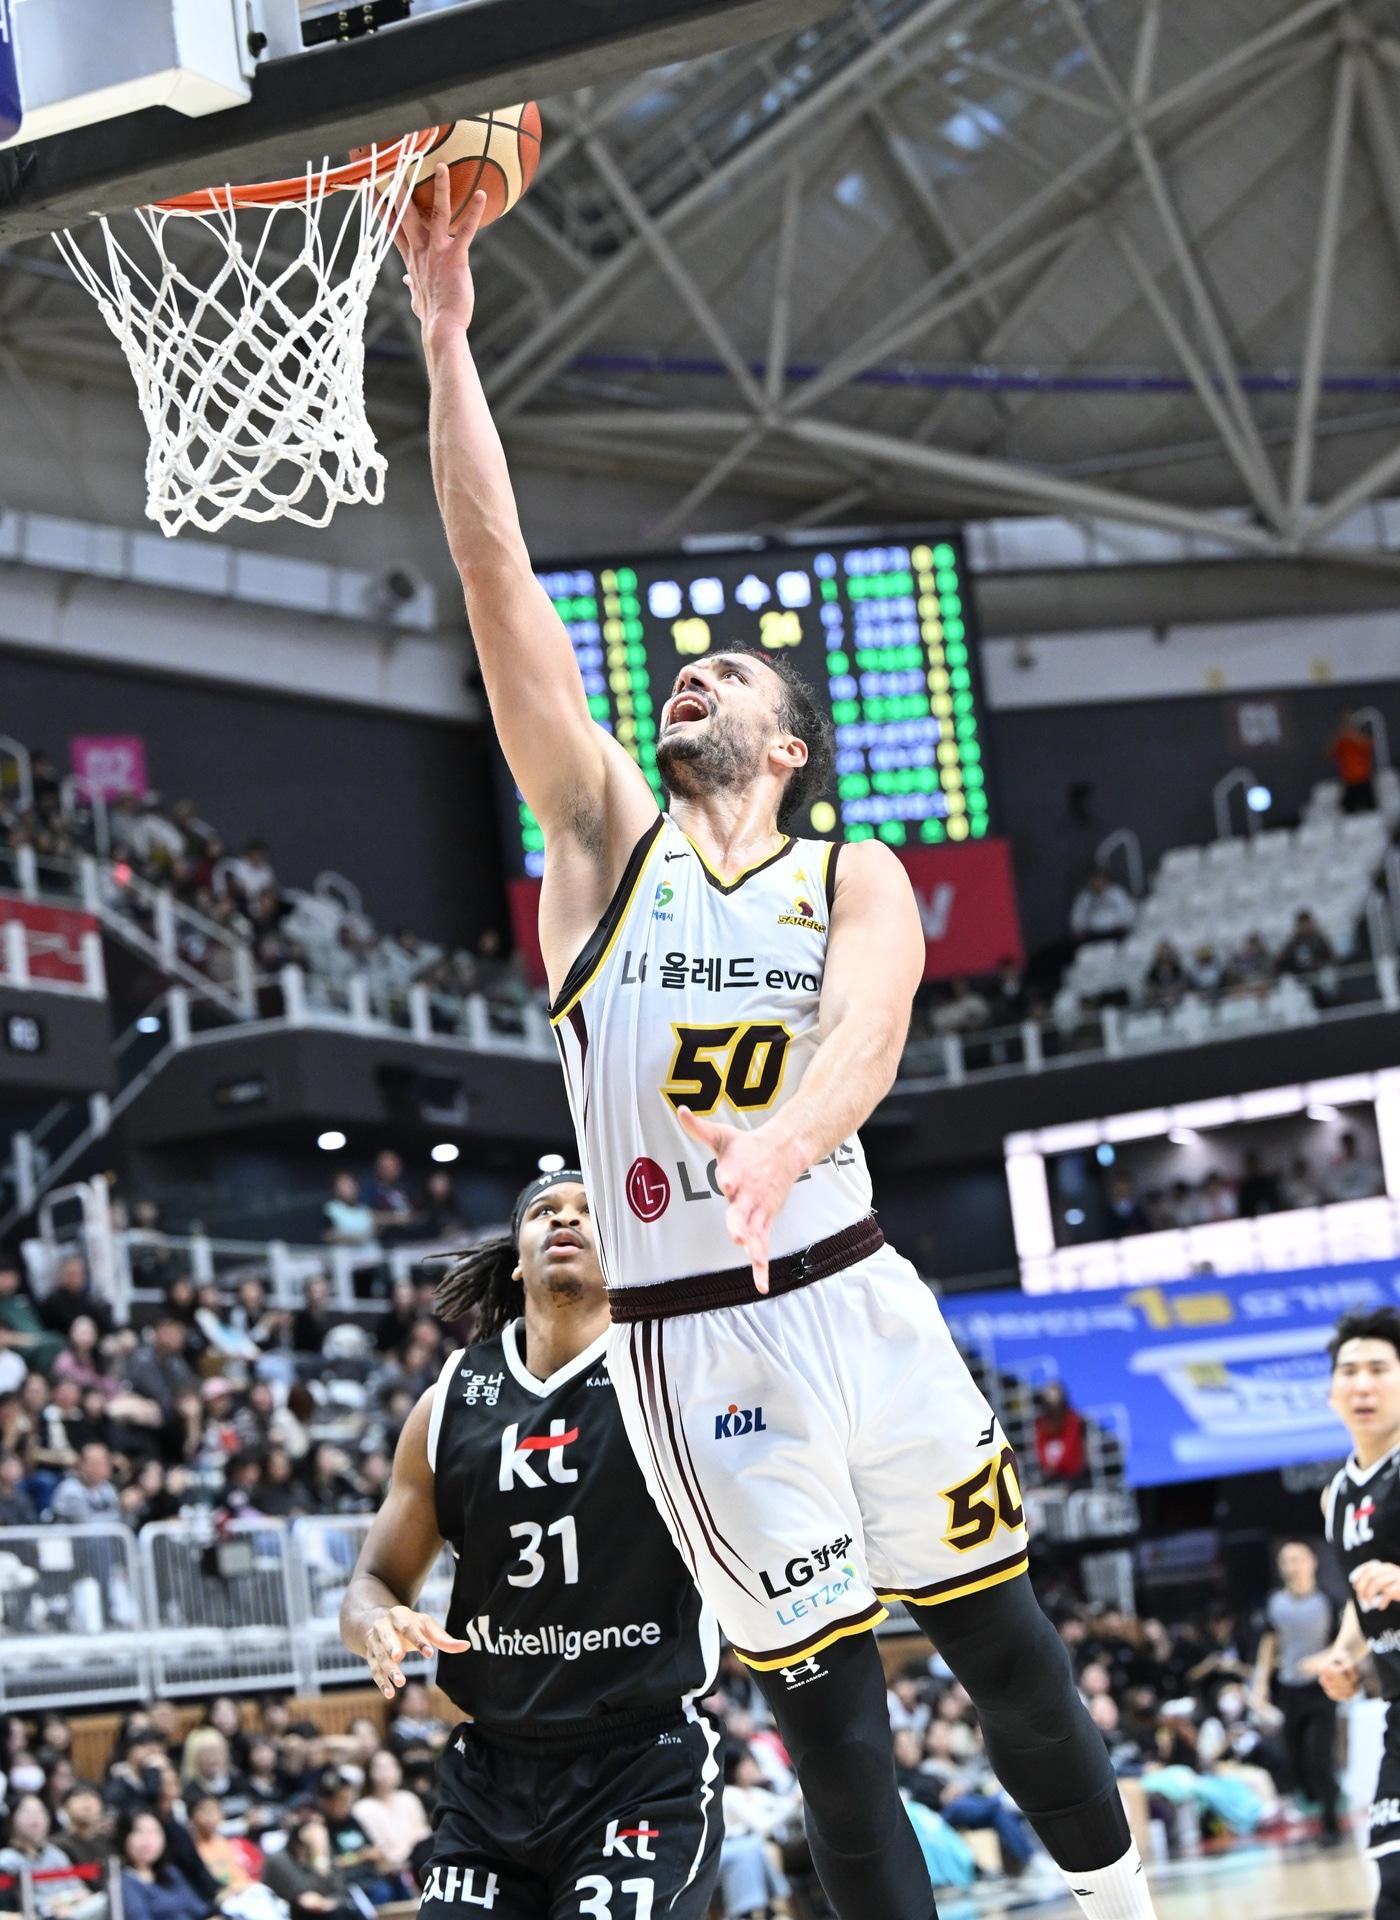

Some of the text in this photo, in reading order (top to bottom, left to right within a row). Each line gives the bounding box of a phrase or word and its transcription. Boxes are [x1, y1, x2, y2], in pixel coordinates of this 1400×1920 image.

[659, 951, 760, 993] 올레드
[765, 968, 819, 992] evo
[657, 1020, 795, 1117] 50
[462, 1385, 500, 1406] 용평
[467, 1371, 506, 1388] 모나
[586, 1377, 611, 1387] KAM
[714, 1404, 767, 1440] KBL
[498, 1418, 580, 1492] kt
[936, 1441, 1026, 1555] 50
[507, 1515, 579, 1588] 31
[602, 1818, 660, 1861] kt
[574, 1874, 656, 1920] 31
